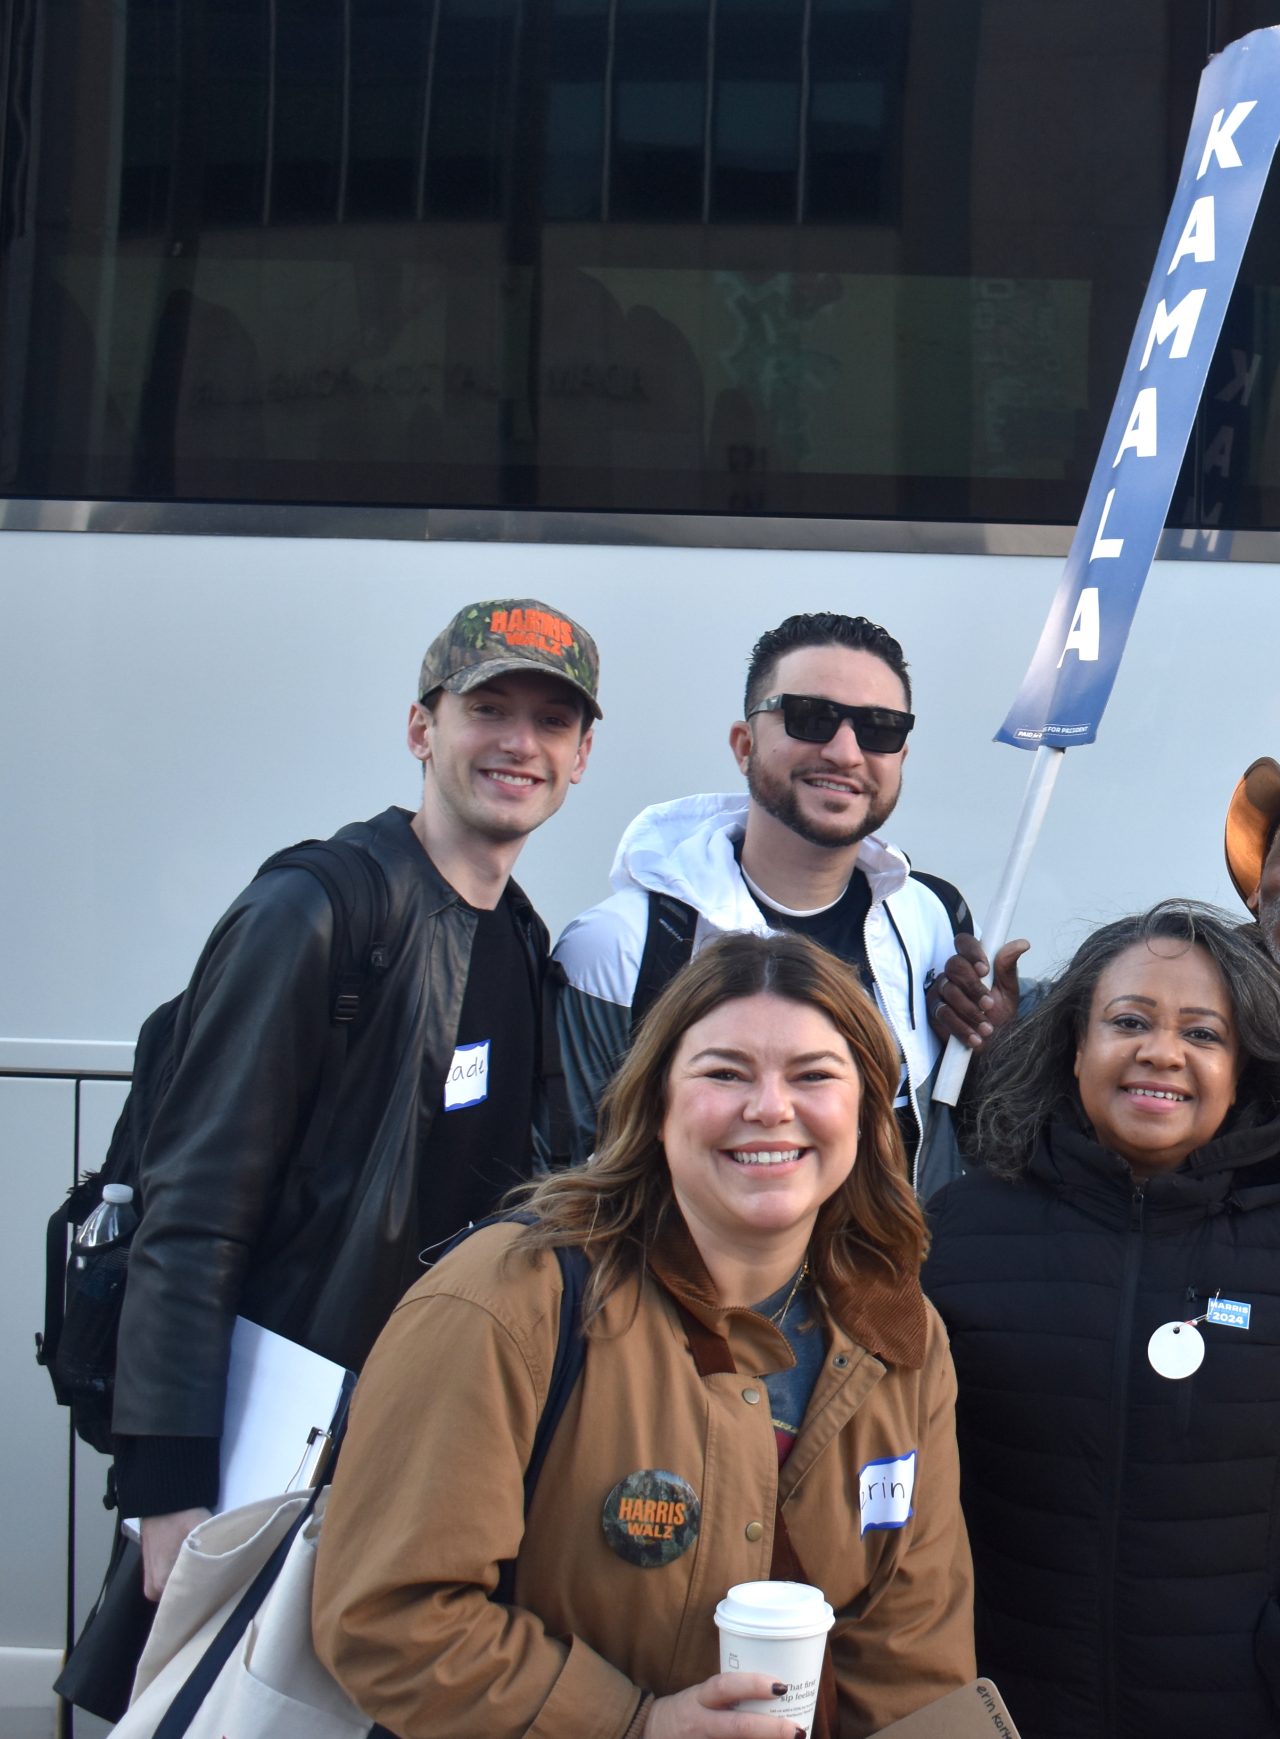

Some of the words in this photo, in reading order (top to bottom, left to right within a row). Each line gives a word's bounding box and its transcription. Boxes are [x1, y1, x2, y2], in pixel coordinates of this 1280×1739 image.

[1057, 100, 1258, 668] KAMALA
[490, 608, 573, 646] HARRIS
[1210, 1301, 1249, 1313] HARRIS
[1212, 1312, 1244, 1324] 2024
[619, 1497, 686, 1526] HARRIS
[627, 1523, 673, 1540] WALZ
[976, 1685, 996, 1713] erin
